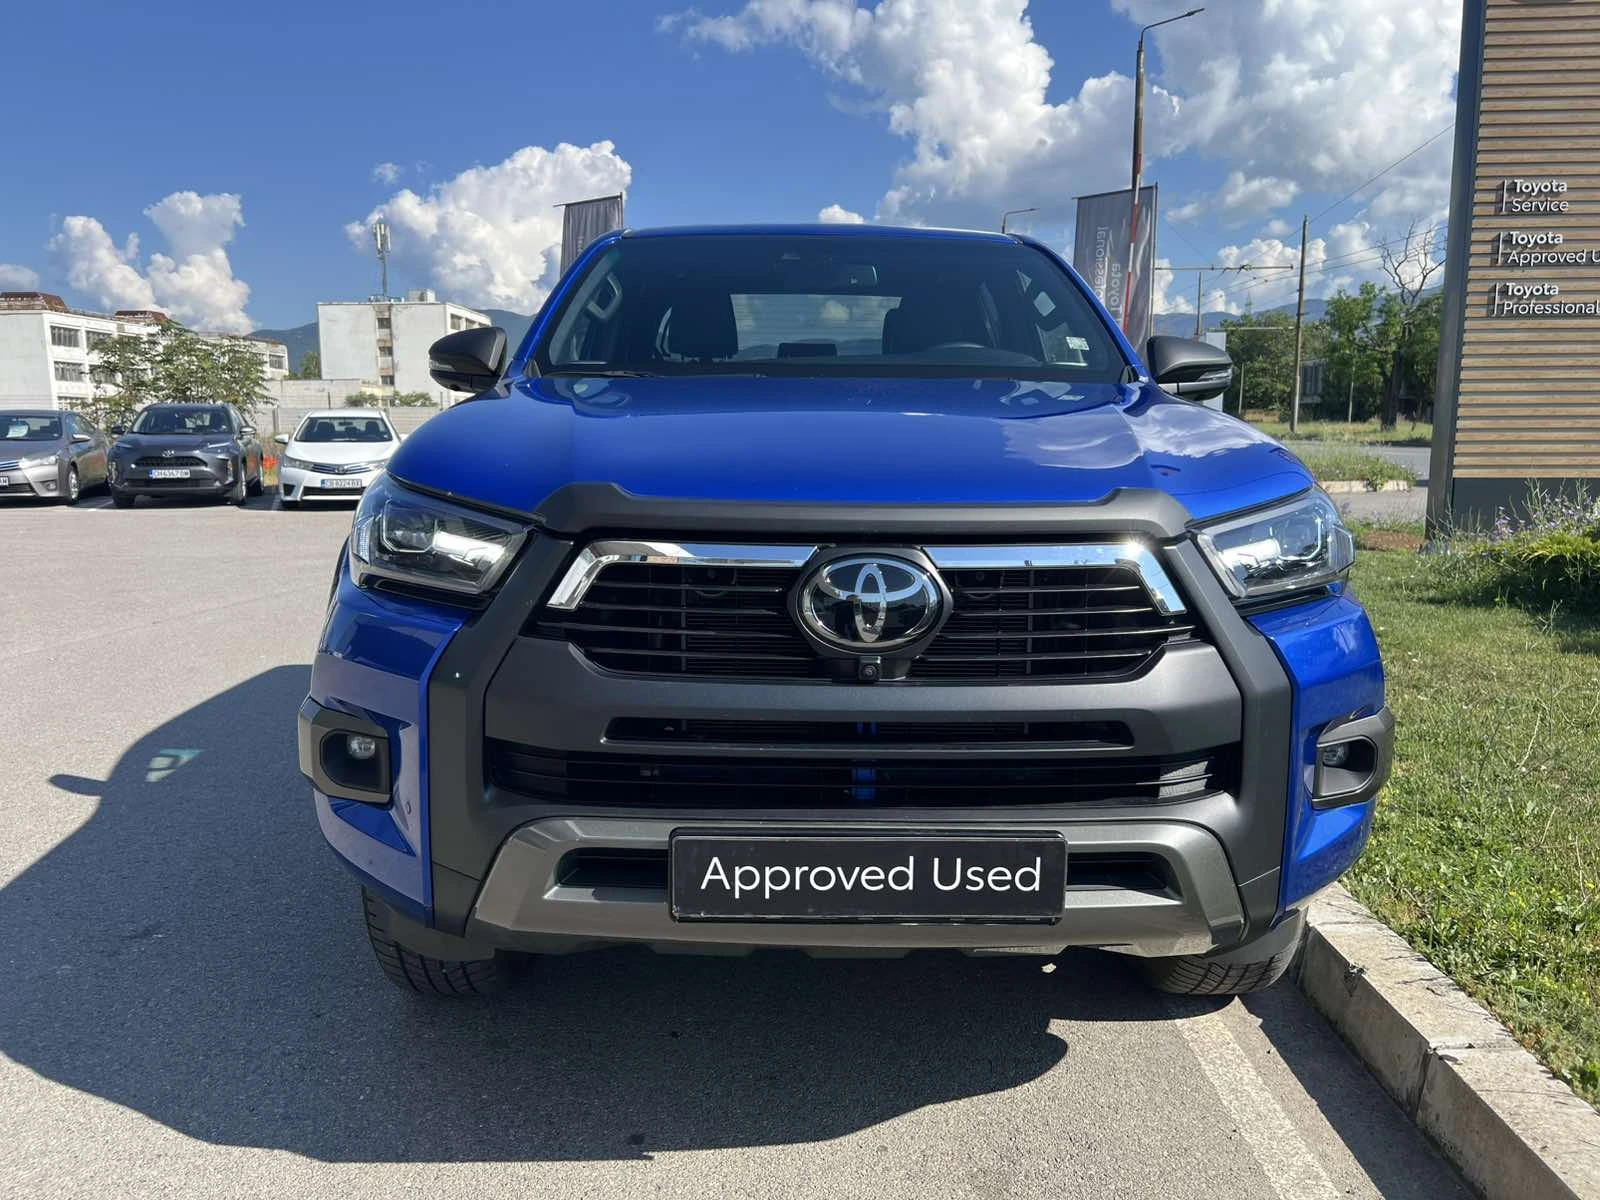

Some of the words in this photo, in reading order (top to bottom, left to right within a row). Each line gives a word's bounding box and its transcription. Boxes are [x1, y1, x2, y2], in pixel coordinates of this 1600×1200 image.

[1514, 179, 1568, 196] Toyota
[1511, 197, 1569, 212] Service
[1509, 231, 1563, 248] Toyota
[1507, 248, 1587, 267] Approved
[1505, 282, 1560, 299] Toyota
[1503, 299, 1600, 315] Professional
[700, 855, 915, 899] Approved
[932, 856, 1041, 892] Used
